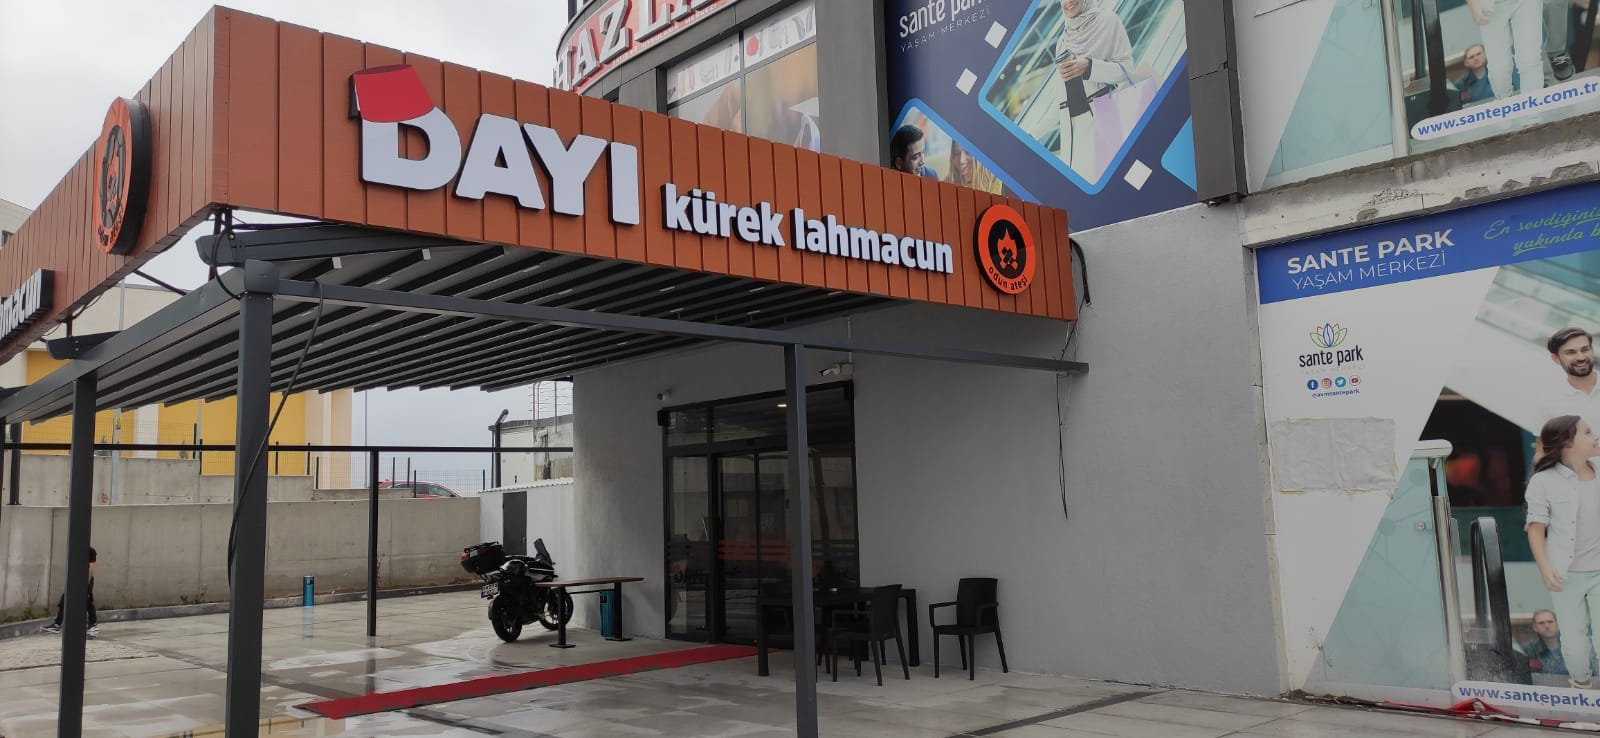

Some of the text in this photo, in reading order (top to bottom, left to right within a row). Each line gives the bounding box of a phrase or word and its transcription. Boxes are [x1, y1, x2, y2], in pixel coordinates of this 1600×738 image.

[900, 0, 946, 38] sante
[1417, 82, 1599, 136] www.santepark.com.tr
[359, 105, 640, 226] DAYI
[662, 183, 954, 273] kürek lahmacun
[1484, 219, 1511, 240] En
[1287, 229, 1455, 275] SANTE PARK
[1292, 250, 1446, 290] YAŞAM MERKEZİ
[988, 266, 1009, 289] odun
[1299, 345, 1364, 368] sante park
